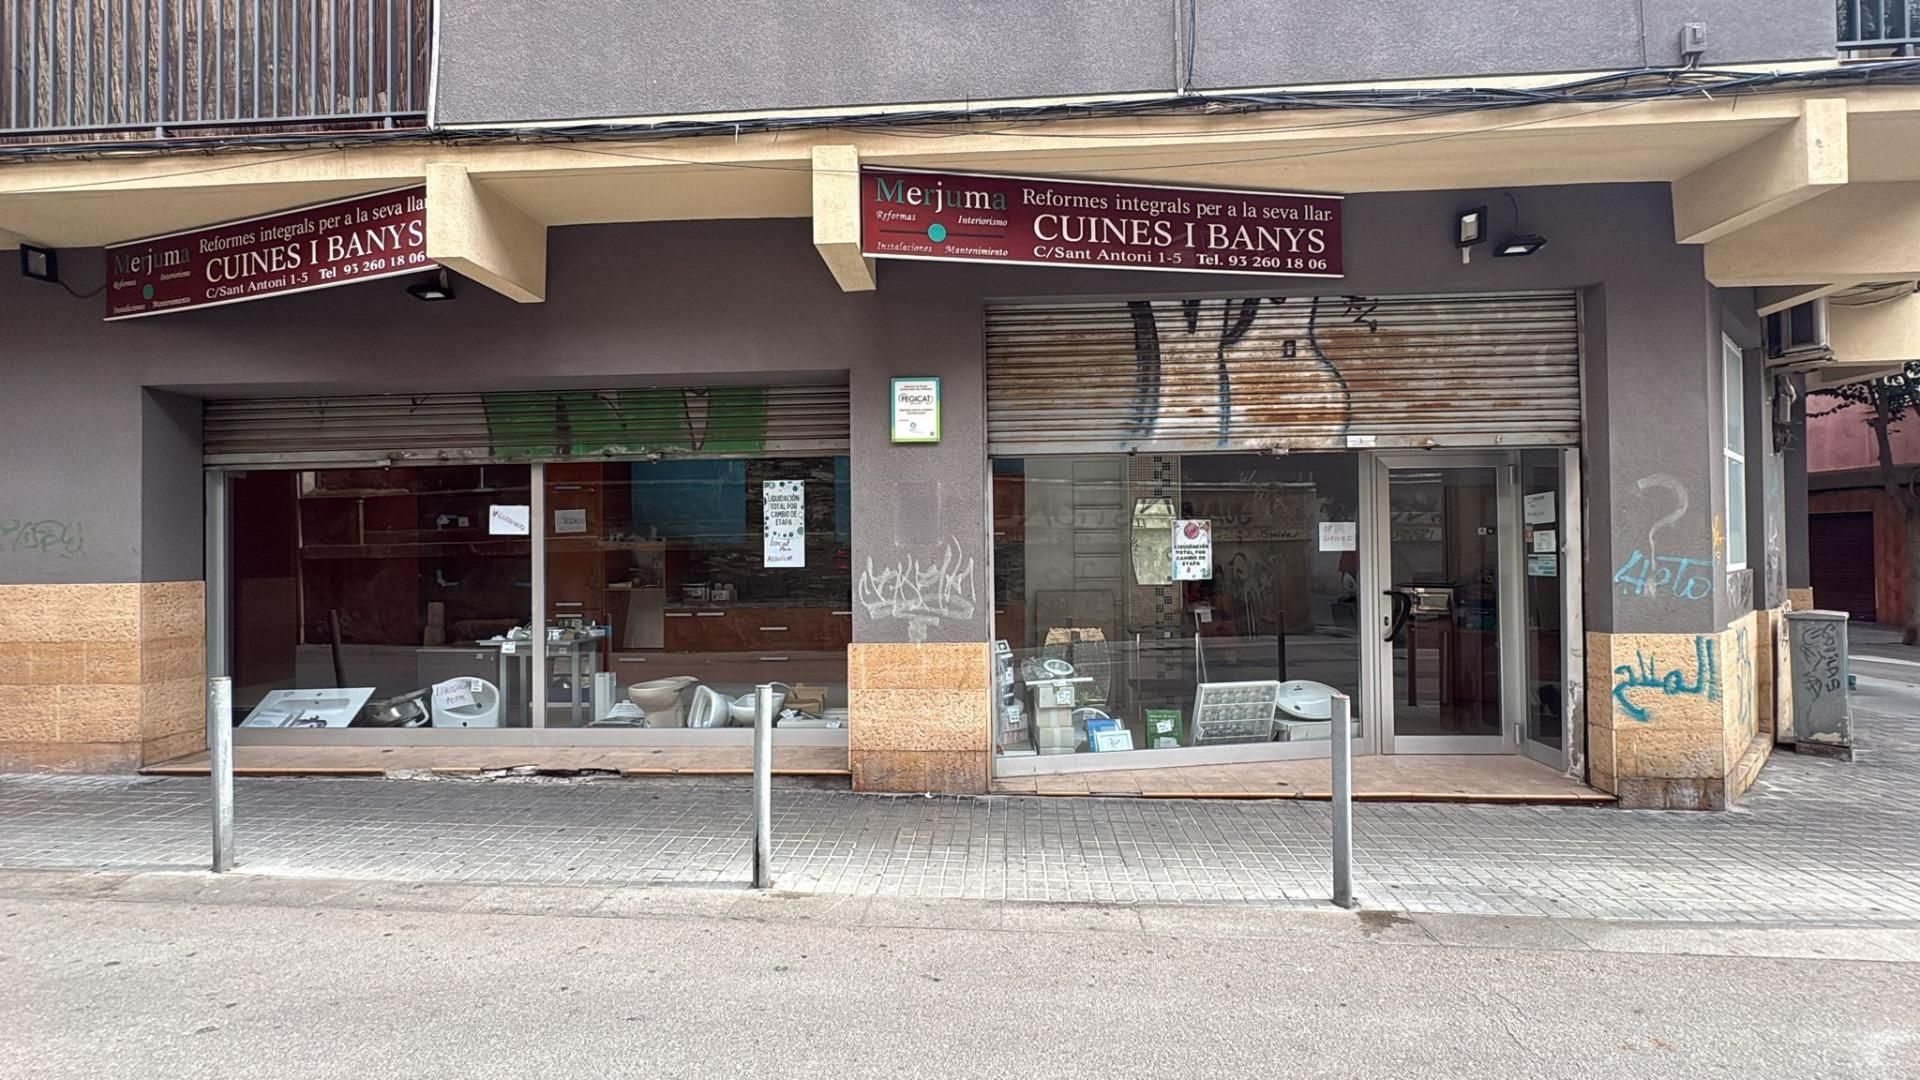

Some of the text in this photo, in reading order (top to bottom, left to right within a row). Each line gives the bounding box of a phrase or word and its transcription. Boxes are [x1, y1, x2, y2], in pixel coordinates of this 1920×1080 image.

[875, 177, 1007, 213] Merjuma
[1022, 188, 1108, 209] Reformes
[1116, 193, 1190, 217] integrals
[1197, 203, 1222, 218] per
[1227, 203, 1237, 217] a
[1243, 202, 1257, 218] la
[1262, 206, 1299, 220] seva
[199, 232, 256, 254] Reformes
[260, 217, 315, 242] integrals
[319, 215, 341, 235] per
[344, 213, 352, 226] a
[356, 207, 368, 223] la
[372, 203, 403, 220] seva
[876, 210, 1008, 227] Reformas Interiorismo
[1033, 214, 1325, 254] CUINES I BANYS
[114, 247, 190, 276] Merjuma
[206, 219, 423, 283] CUINES I BANYS
[945, 245, 1008, 257] Mantenimiento
[1033, 245, 1327, 270] C/Sant Antoni 1-5 Tel. 93 260 18 06
[206, 284, 244, 299] C/Sant
[247, 275, 286, 292] Antoni
[290, 272, 309, 285] 1-5
[343, 264, 359, 275] 93
[363, 258, 385, 272] 260
[391, 255, 405, 267] 18
[409, 250, 425, 264] 06
